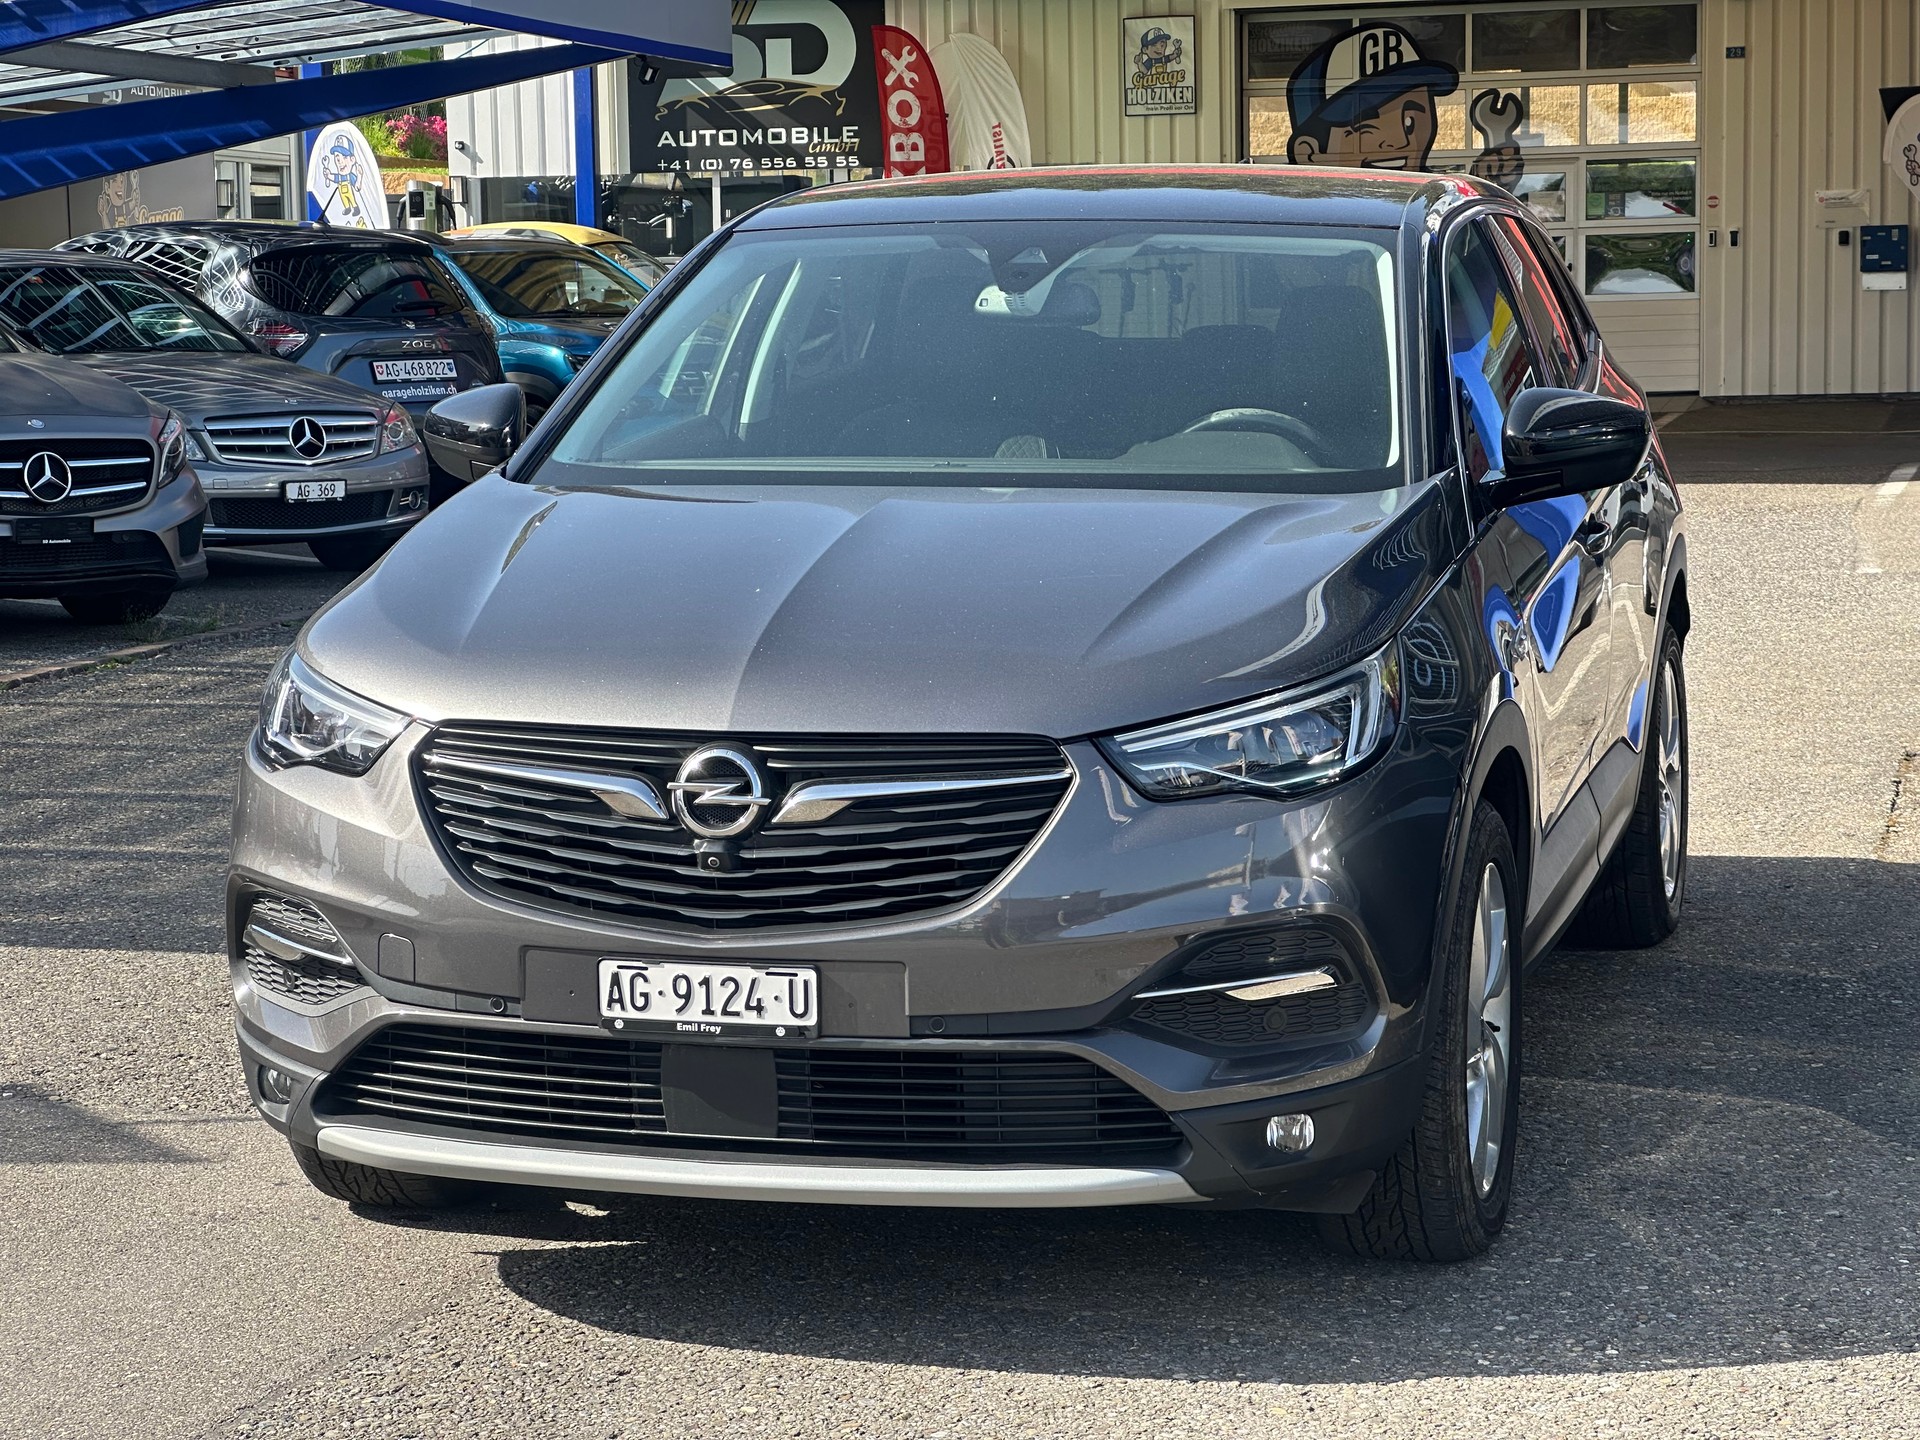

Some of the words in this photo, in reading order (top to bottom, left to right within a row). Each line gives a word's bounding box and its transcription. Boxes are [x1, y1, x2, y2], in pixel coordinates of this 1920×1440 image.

[1360, 30, 1404, 77] GB
[1730, 48, 1742, 57] 29
[1132, 69, 1185, 90] Garage
[1127, 86, 1194, 105] HOLZIKEN
[657, 126, 859, 147] AUTOMOBILE
[808, 137, 860, 153] GmbH
[657, 159, 691, 171] +41
[700, 158, 723, 170] (0)
[730, 158, 753, 169] 76
[761, 158, 797, 168] 556
[804, 156, 828, 168] 55
[836, 156, 860, 167] 55
[676, 1022, 698, 1032] Emil
[701, 1023, 722, 1034] Frey
